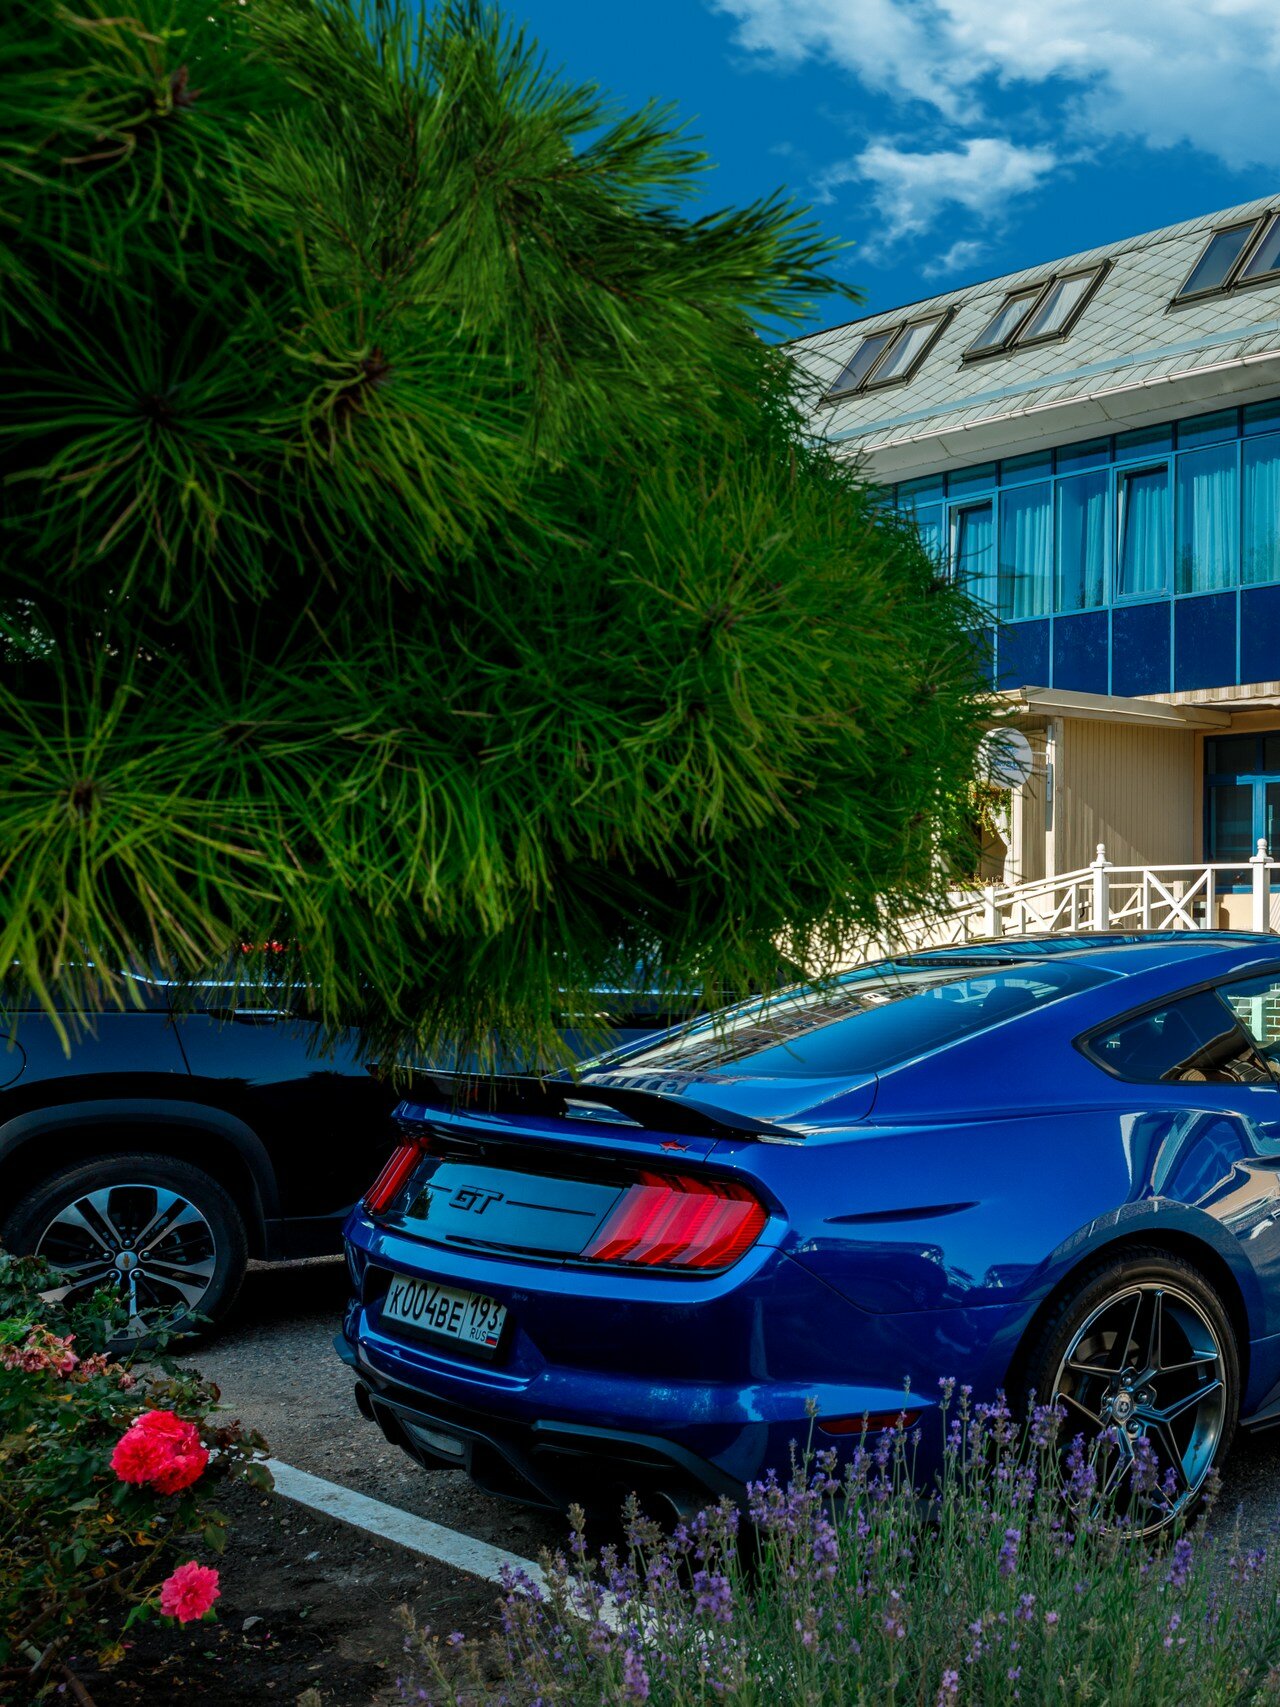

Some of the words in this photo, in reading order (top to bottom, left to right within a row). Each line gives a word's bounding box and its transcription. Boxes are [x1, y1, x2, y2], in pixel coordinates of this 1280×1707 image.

[449, 1184, 504, 1215] GT
[470, 1295, 501, 1331] 193
[469, 1327, 487, 1342] RUS
